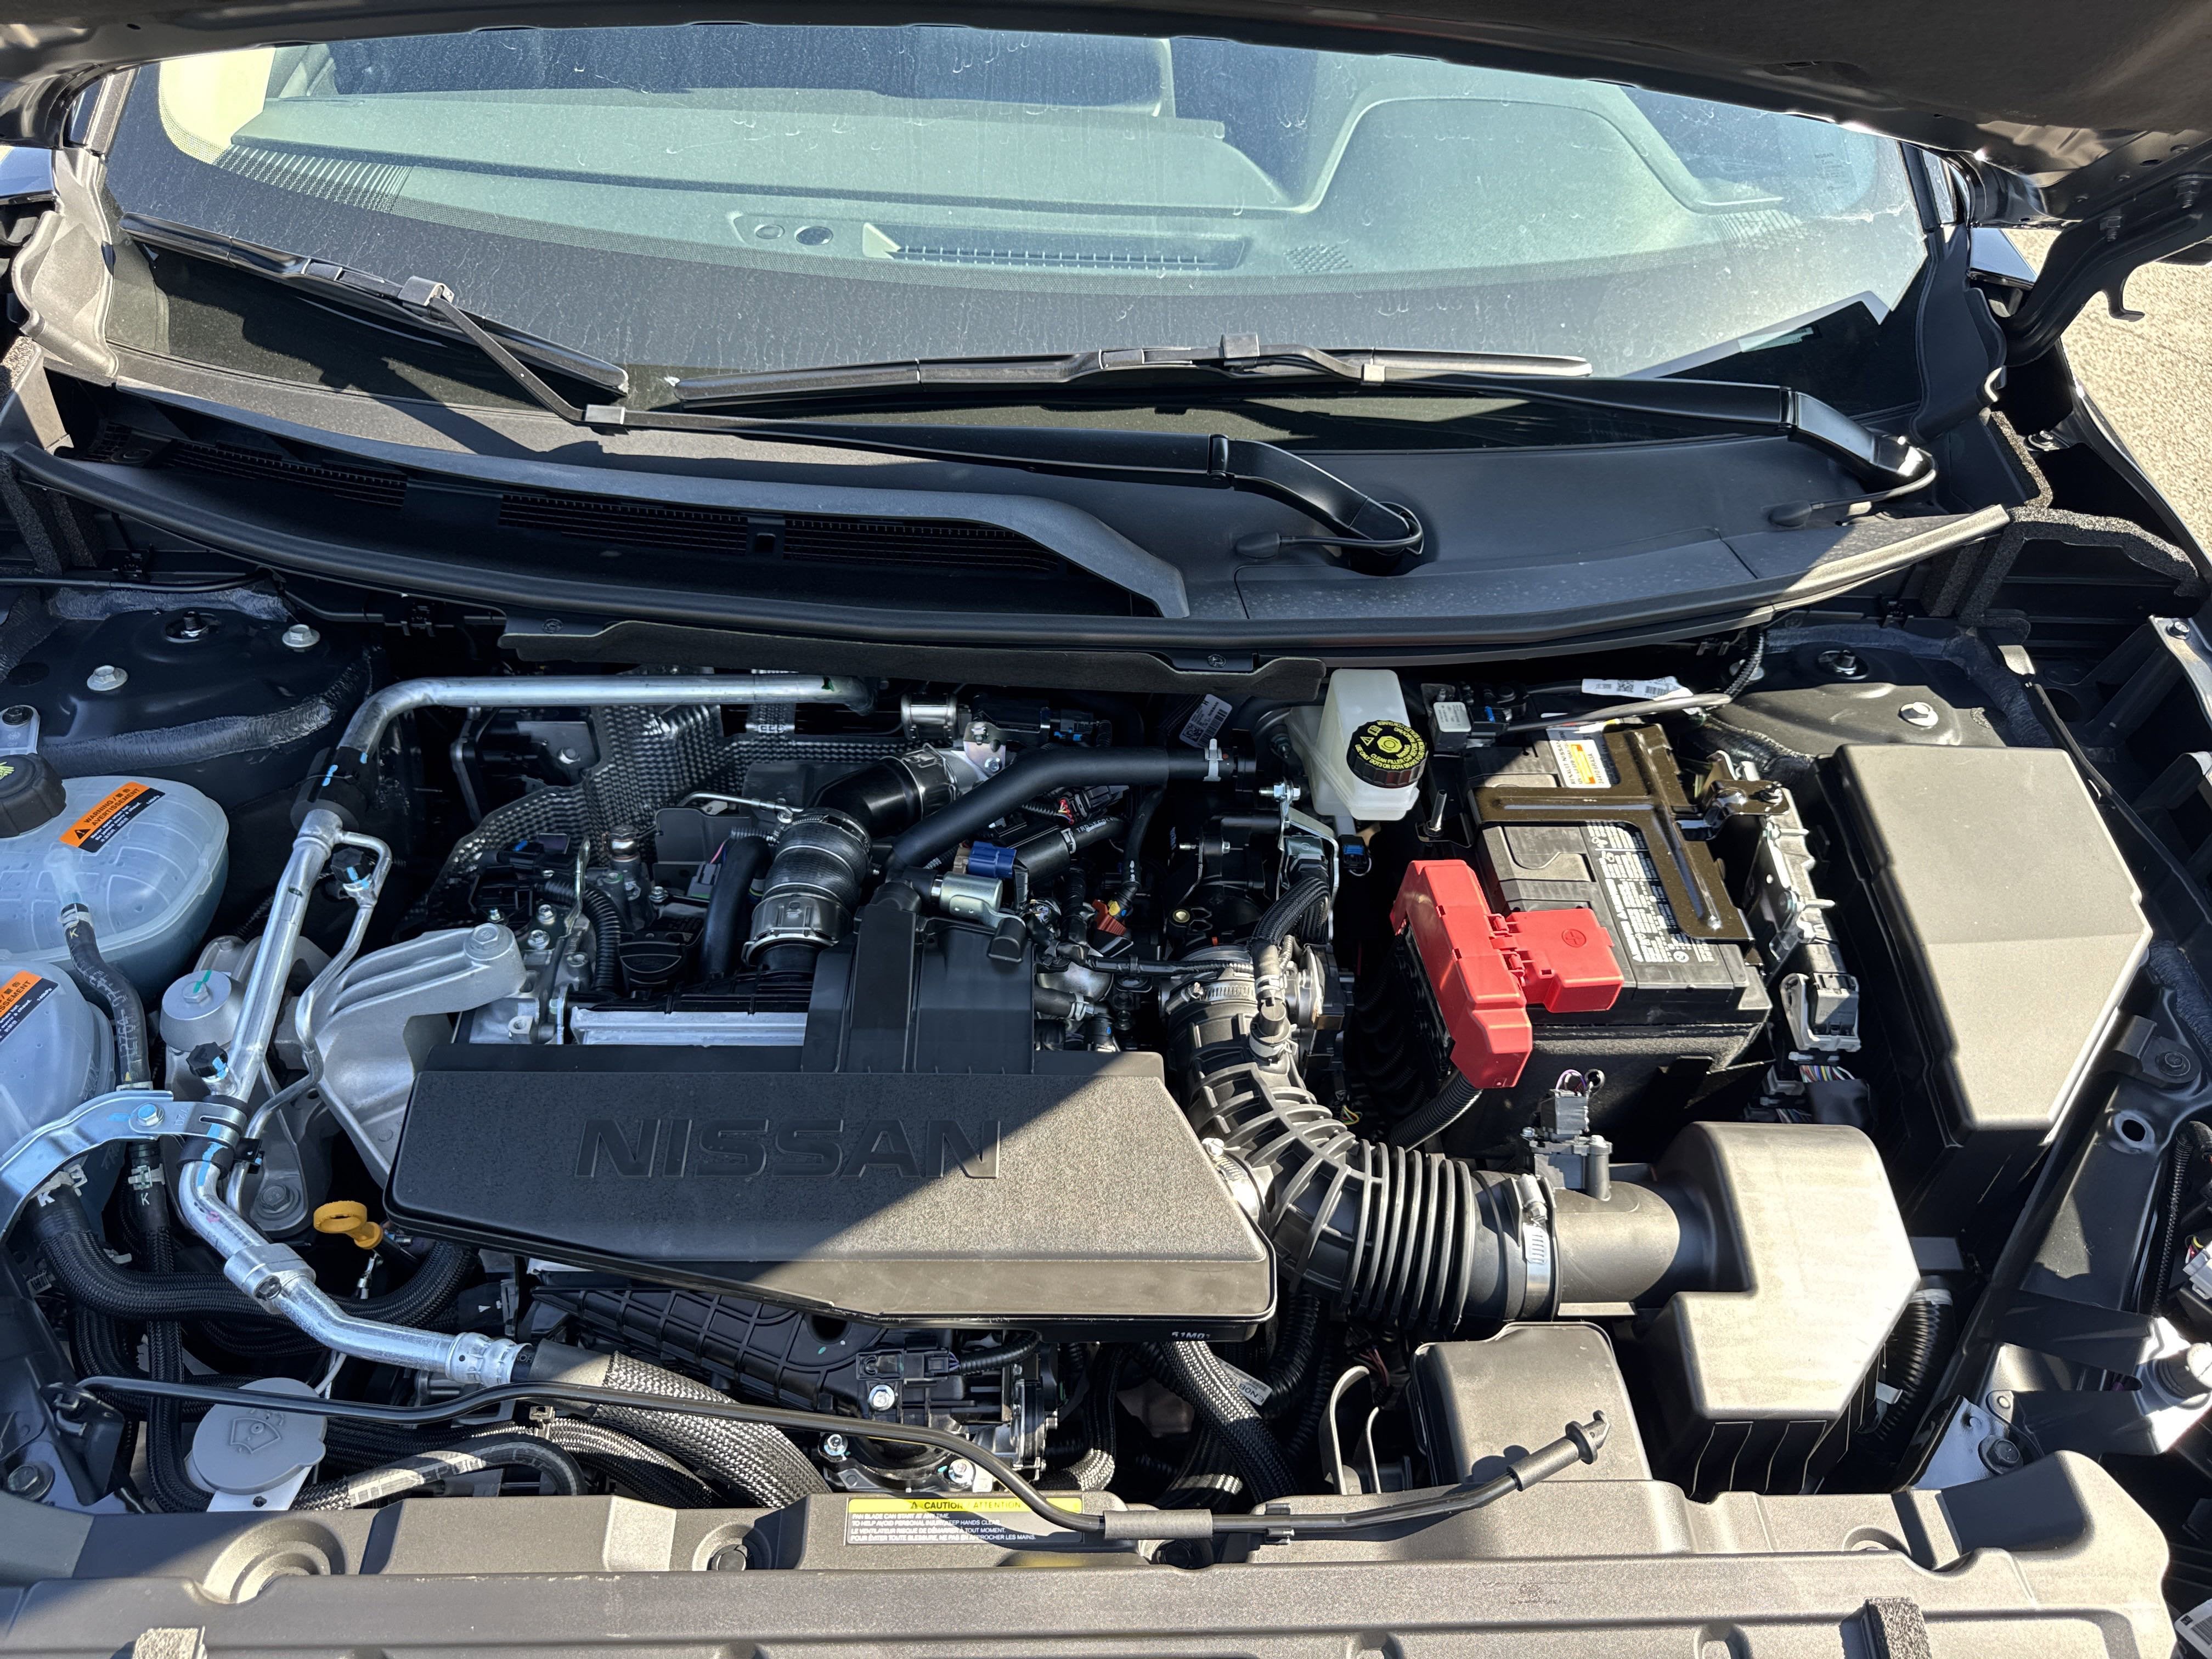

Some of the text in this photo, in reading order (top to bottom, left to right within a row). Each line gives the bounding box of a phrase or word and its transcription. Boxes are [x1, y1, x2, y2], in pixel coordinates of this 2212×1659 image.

[1370, 754, 1386, 763] CLEAN
[83, 800, 113, 824] WARNING
[92, 788, 140, 826] AVERTISSEMENT
[70, 928, 79, 939] K
[574, 1119, 1000, 1178] NISSAN
[37, 1190, 55, 1207] K
[141, 1193, 150, 1205] K
